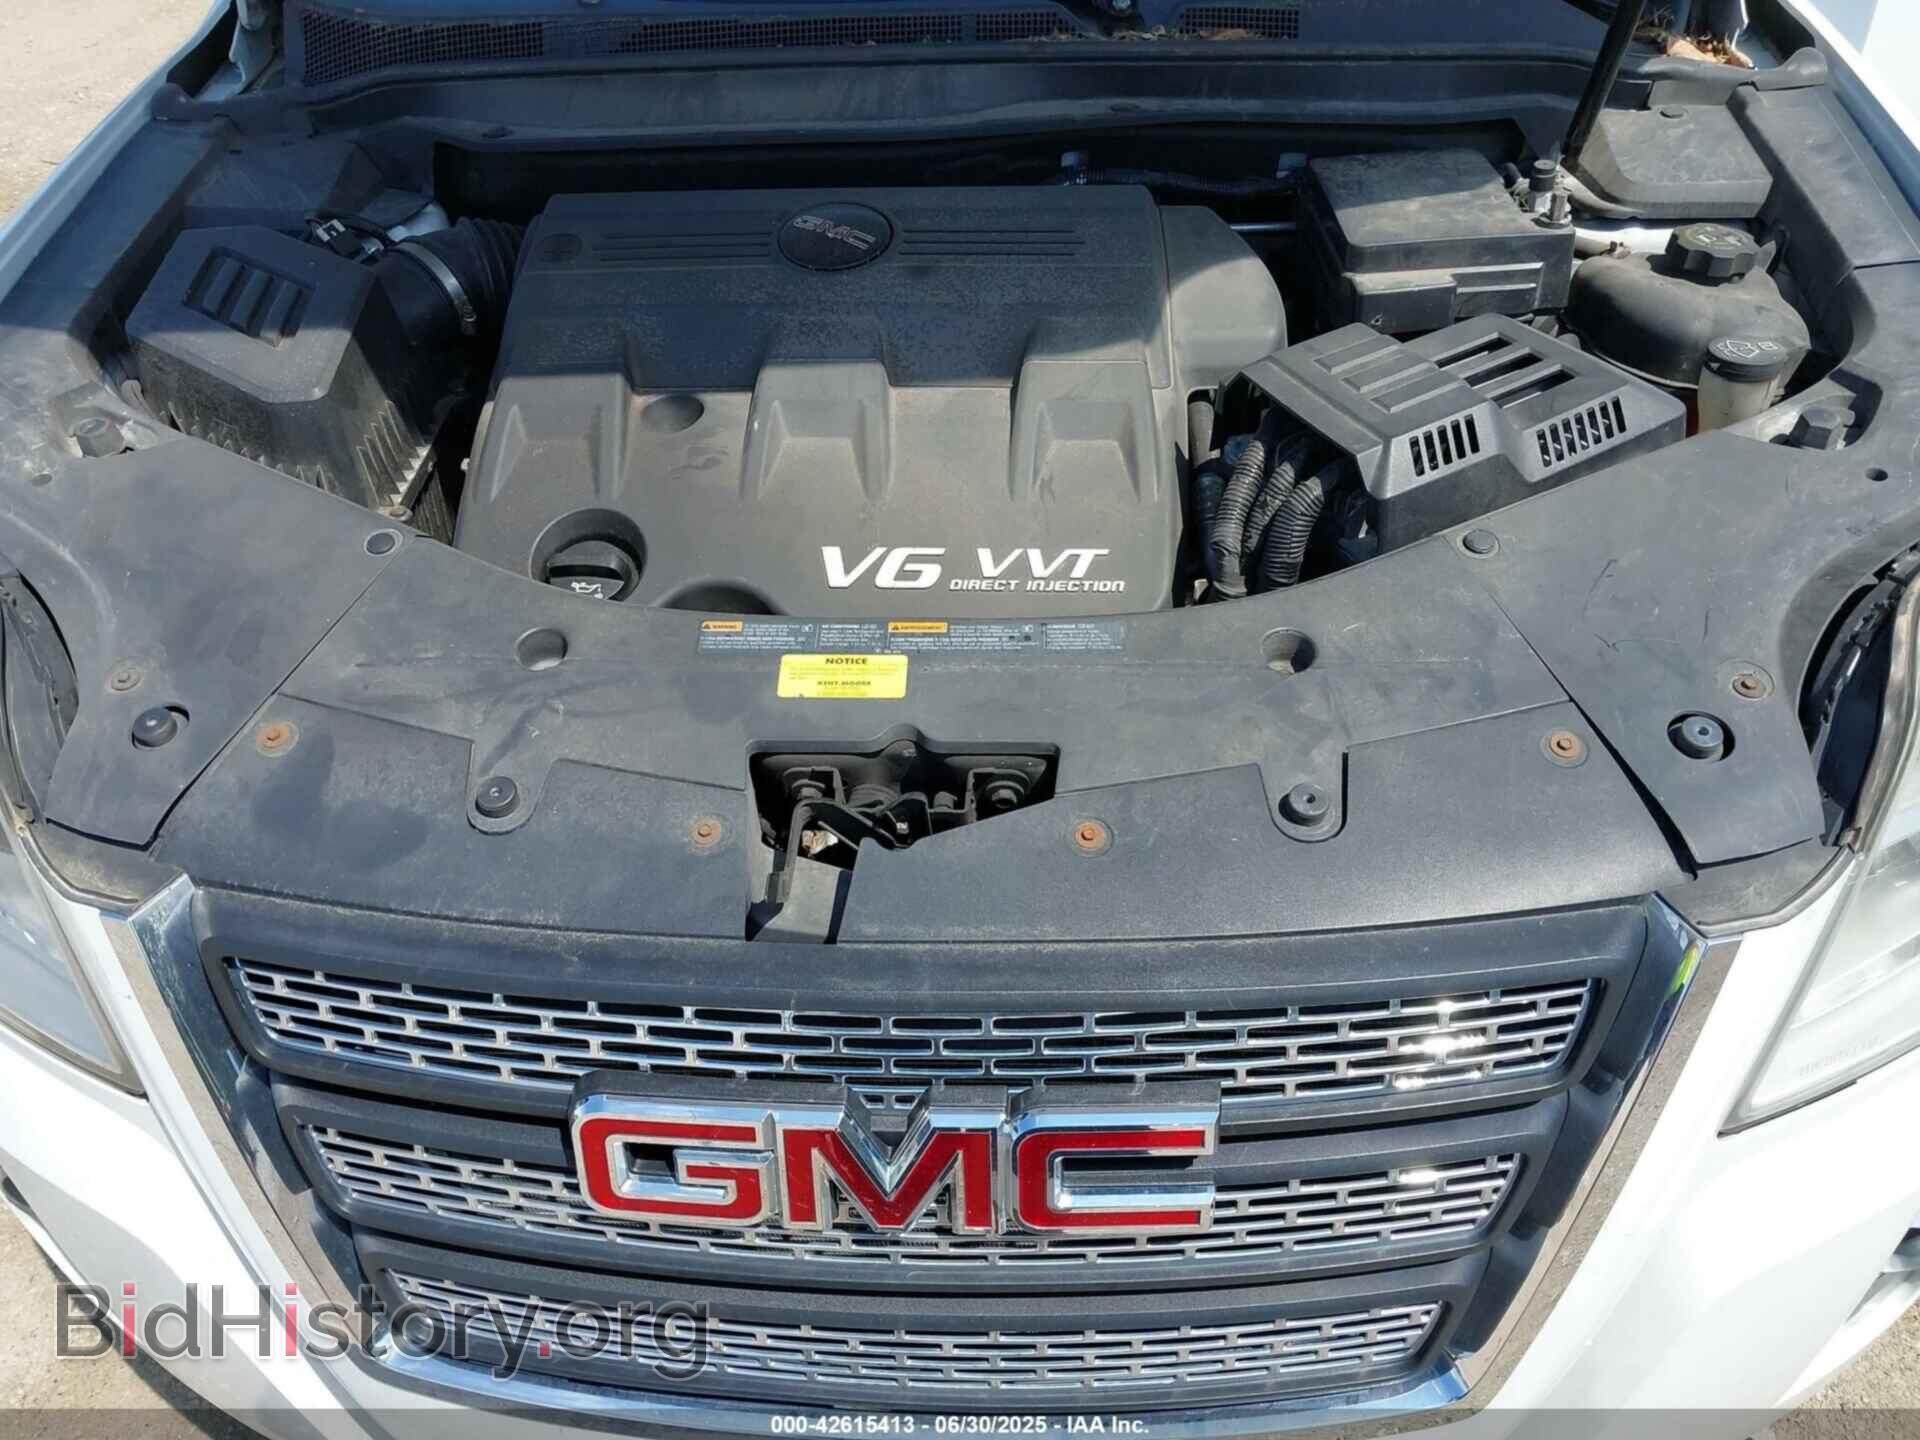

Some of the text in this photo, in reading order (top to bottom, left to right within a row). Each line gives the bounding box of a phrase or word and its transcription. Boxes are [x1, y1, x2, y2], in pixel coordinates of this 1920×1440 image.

[821, 546, 1110, 588] V6 VVT
[950, 579, 1019, 591] DIRECT
[825, 657, 868, 665] NOTICE
[573, 1095, 1219, 1235] GMC
